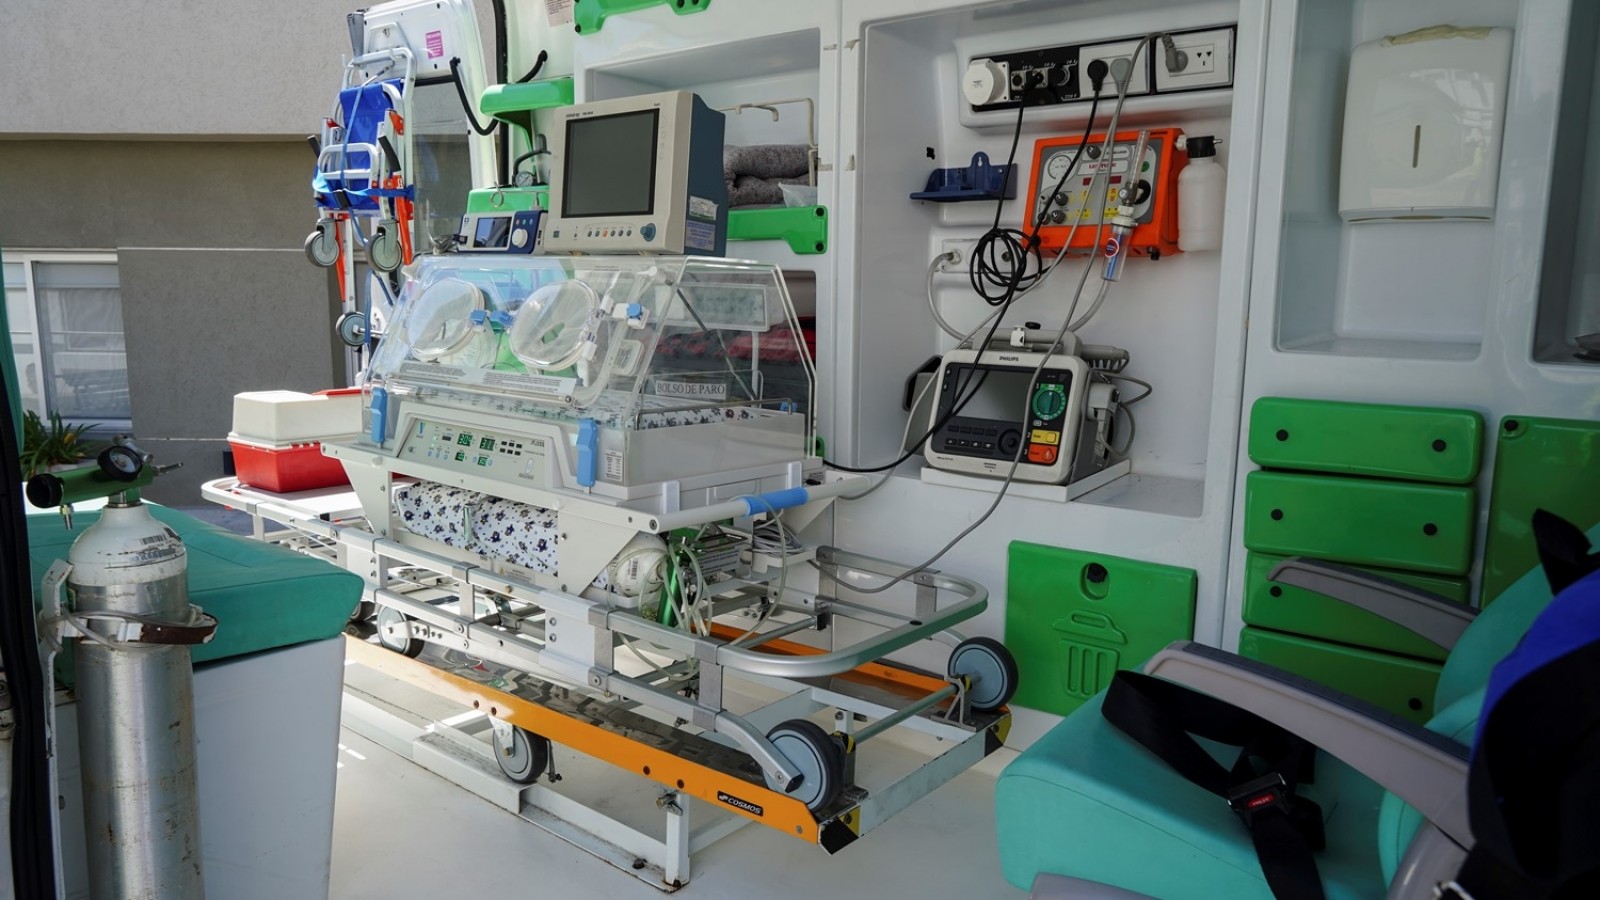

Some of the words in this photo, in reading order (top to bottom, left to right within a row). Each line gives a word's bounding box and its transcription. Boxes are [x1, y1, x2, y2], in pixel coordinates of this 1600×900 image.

[657, 382, 684, 394] BOLSO
[685, 384, 697, 394] DE
[699, 384, 725, 395] PARO
[728, 797, 761, 814] COSMOS
